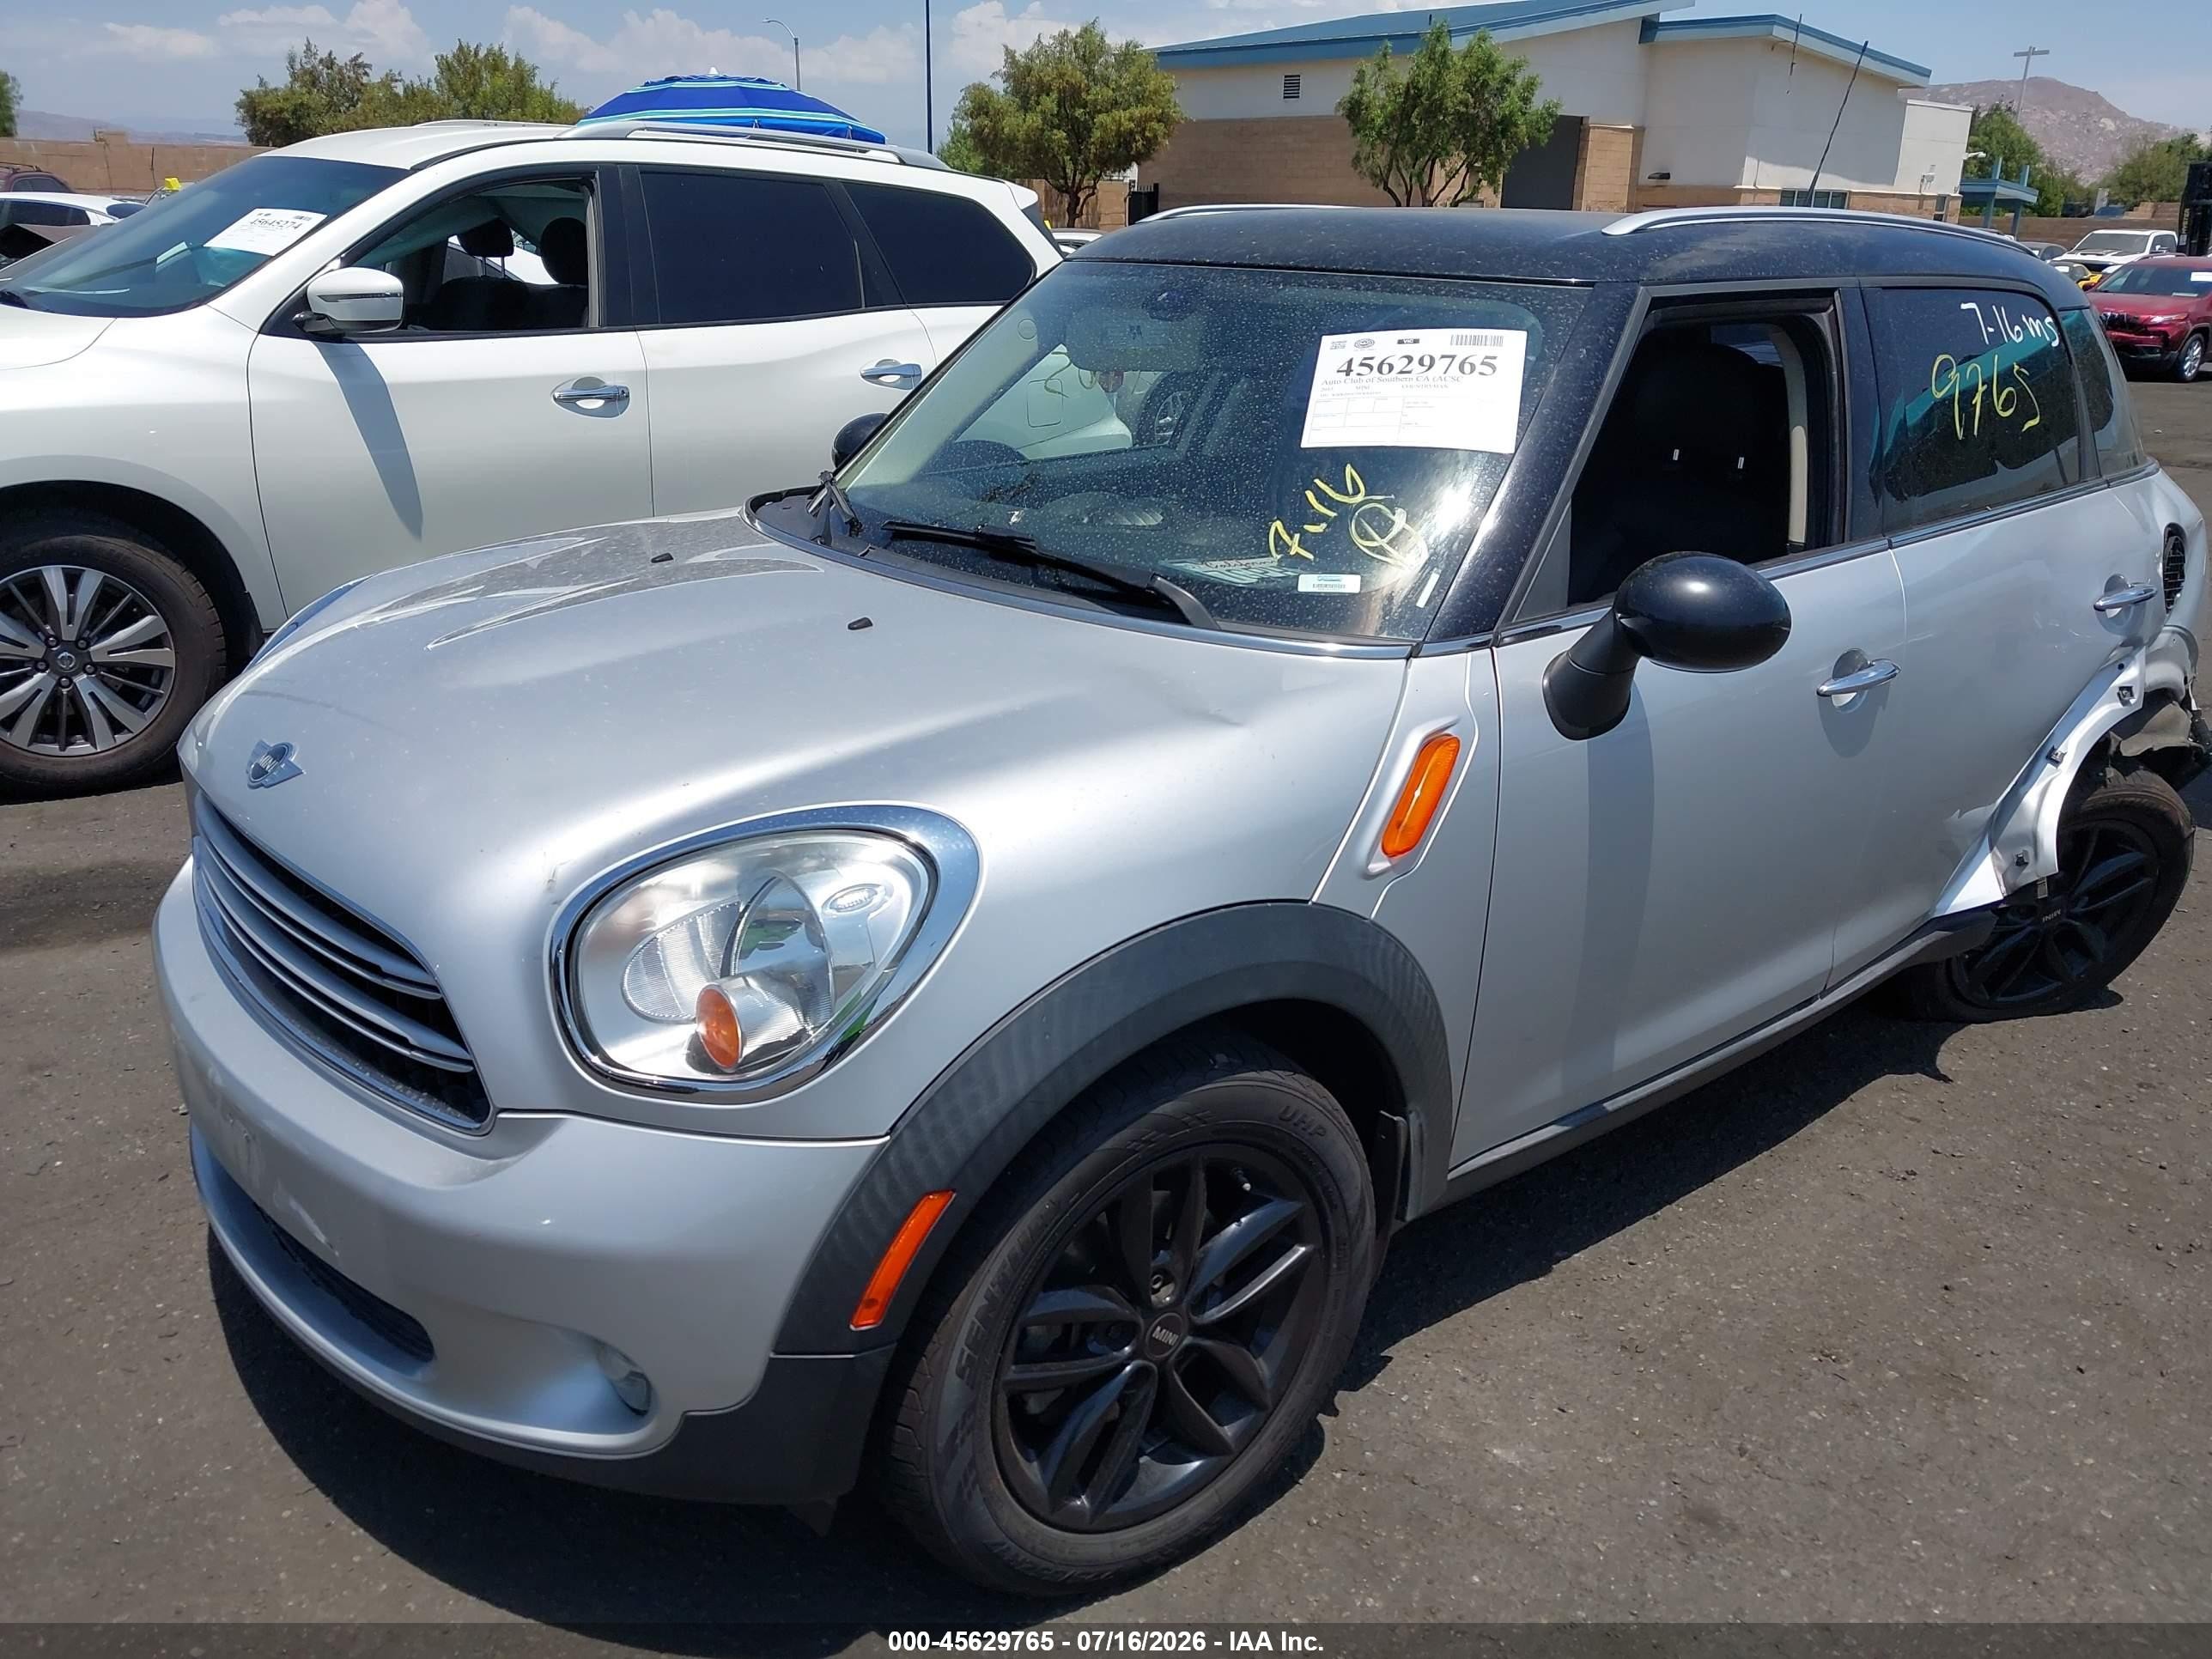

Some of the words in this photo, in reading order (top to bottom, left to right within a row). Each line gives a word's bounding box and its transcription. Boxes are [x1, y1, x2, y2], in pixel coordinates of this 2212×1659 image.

[1960, 302, 2024, 345] 7-16
[1336, 354, 1498, 377] 45629765
[1321, 378, 1341, 386] Auto
[1376, 375, 1414, 384] Southern
[1932, 354, 2041, 441] 9765
[1152, 1325, 1179, 1346] MINI
